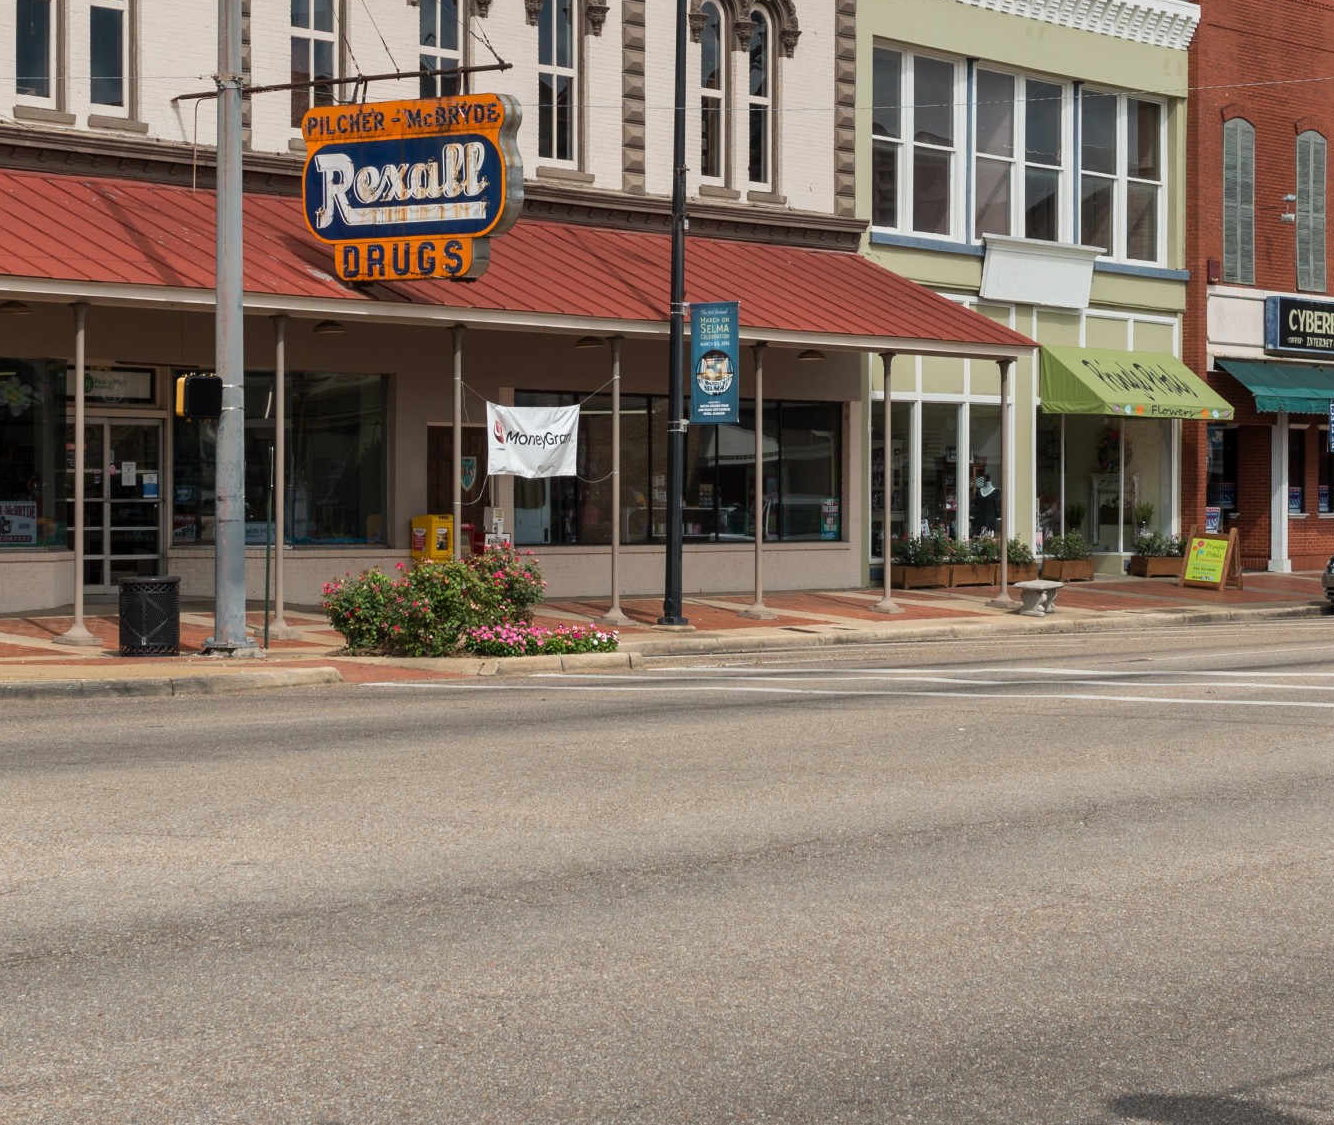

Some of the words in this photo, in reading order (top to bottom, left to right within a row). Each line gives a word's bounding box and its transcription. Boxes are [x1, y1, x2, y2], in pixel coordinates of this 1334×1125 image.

[306, 110, 385, 136] PILCHER
[406, 102, 499, 128] McBRYDE
[315, 141, 487, 228] Rexall
[343, 240, 463, 278] DRUGS
[700, 323, 730, 333] SELMA
[1307, 337, 1333, 348] INTERNET
[1151, 406, 1195, 418] Flowers
